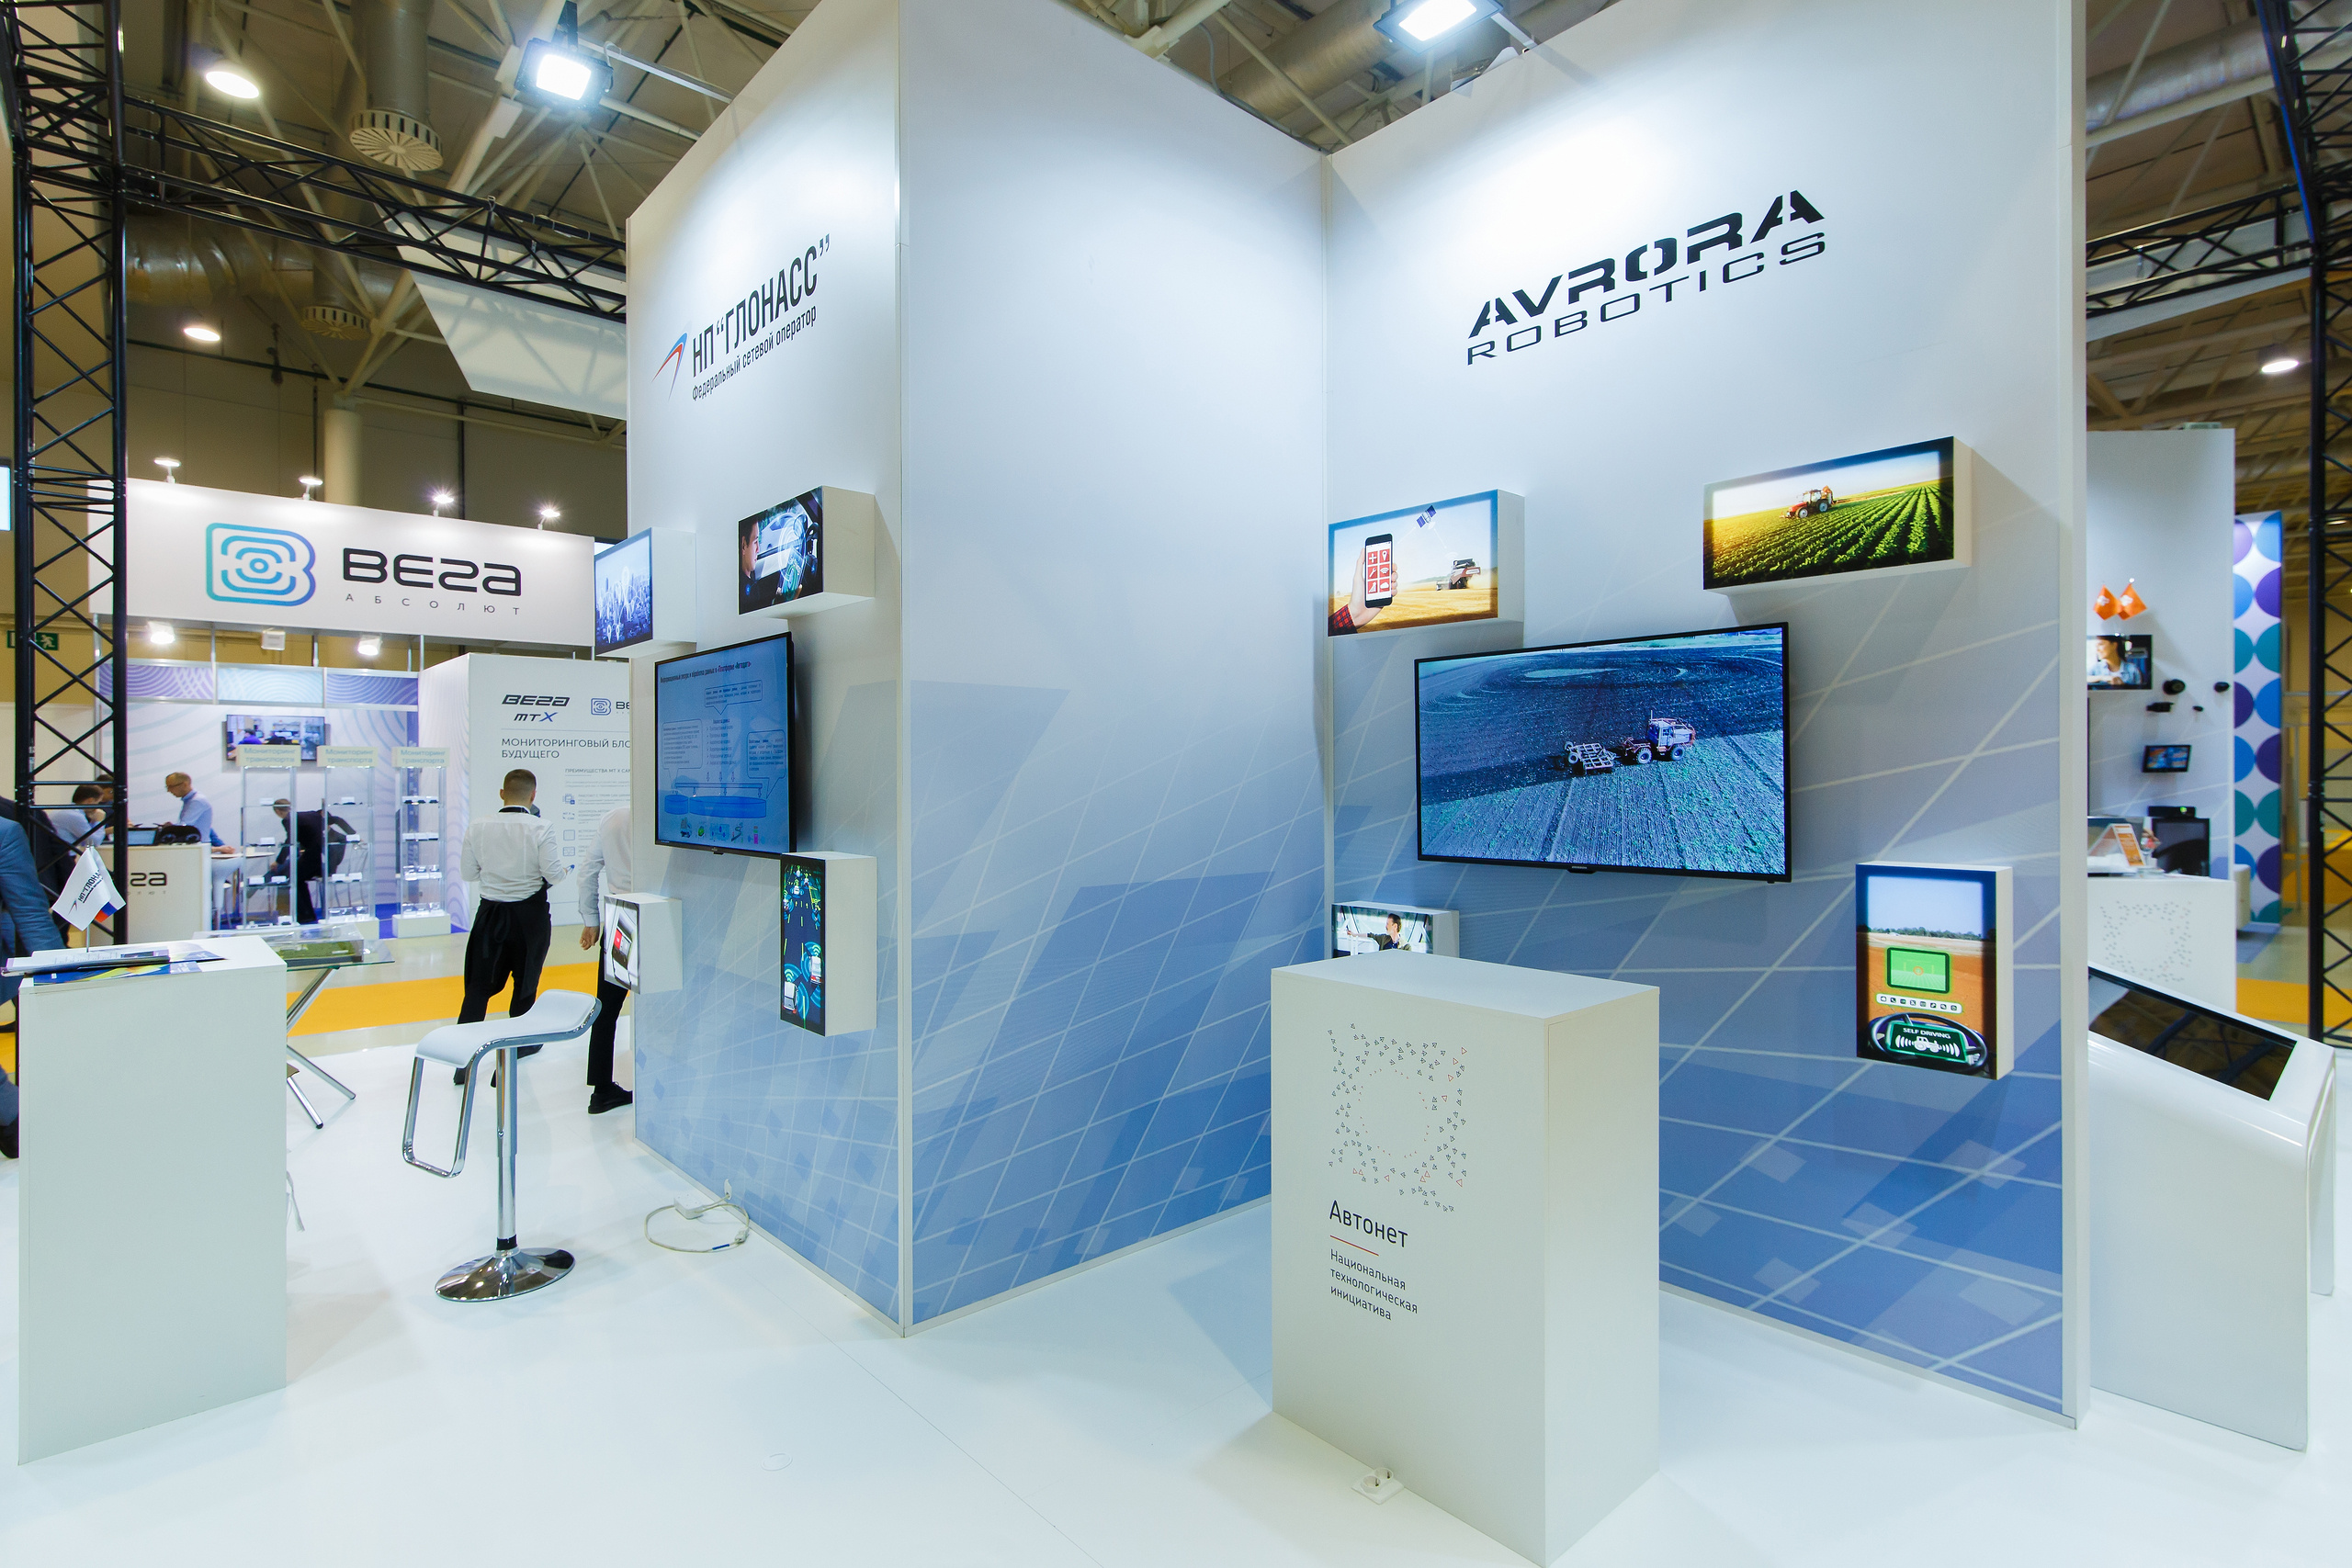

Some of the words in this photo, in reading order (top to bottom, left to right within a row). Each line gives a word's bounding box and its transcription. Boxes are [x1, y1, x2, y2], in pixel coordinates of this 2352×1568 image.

[1467, 189, 1826, 339] AVRORA
[1467, 231, 1826, 367] ROBOTICS
[692, 355, 741, 401] Федеральный
[742, 332, 775, 369] сетевой
[775, 305, 817, 346] оператор
[345, 592, 521, 615] АБСОЛЮТ
[243, 747, 296, 756] Мониторинг
[502, 738, 609, 749] МОНИТОРИНГОВЫЙ
[502, 750, 560, 760] БУДУЩЕГО
[1920, 1030, 1951, 1039] DRIVING
[1329, 1200, 1408, 1248] Автонет
[1330, 1248, 1407, 1292] Национальная
[1330, 1269, 1419, 1314] технологическая
[1330, 1286, 1392, 1321] инициатива
